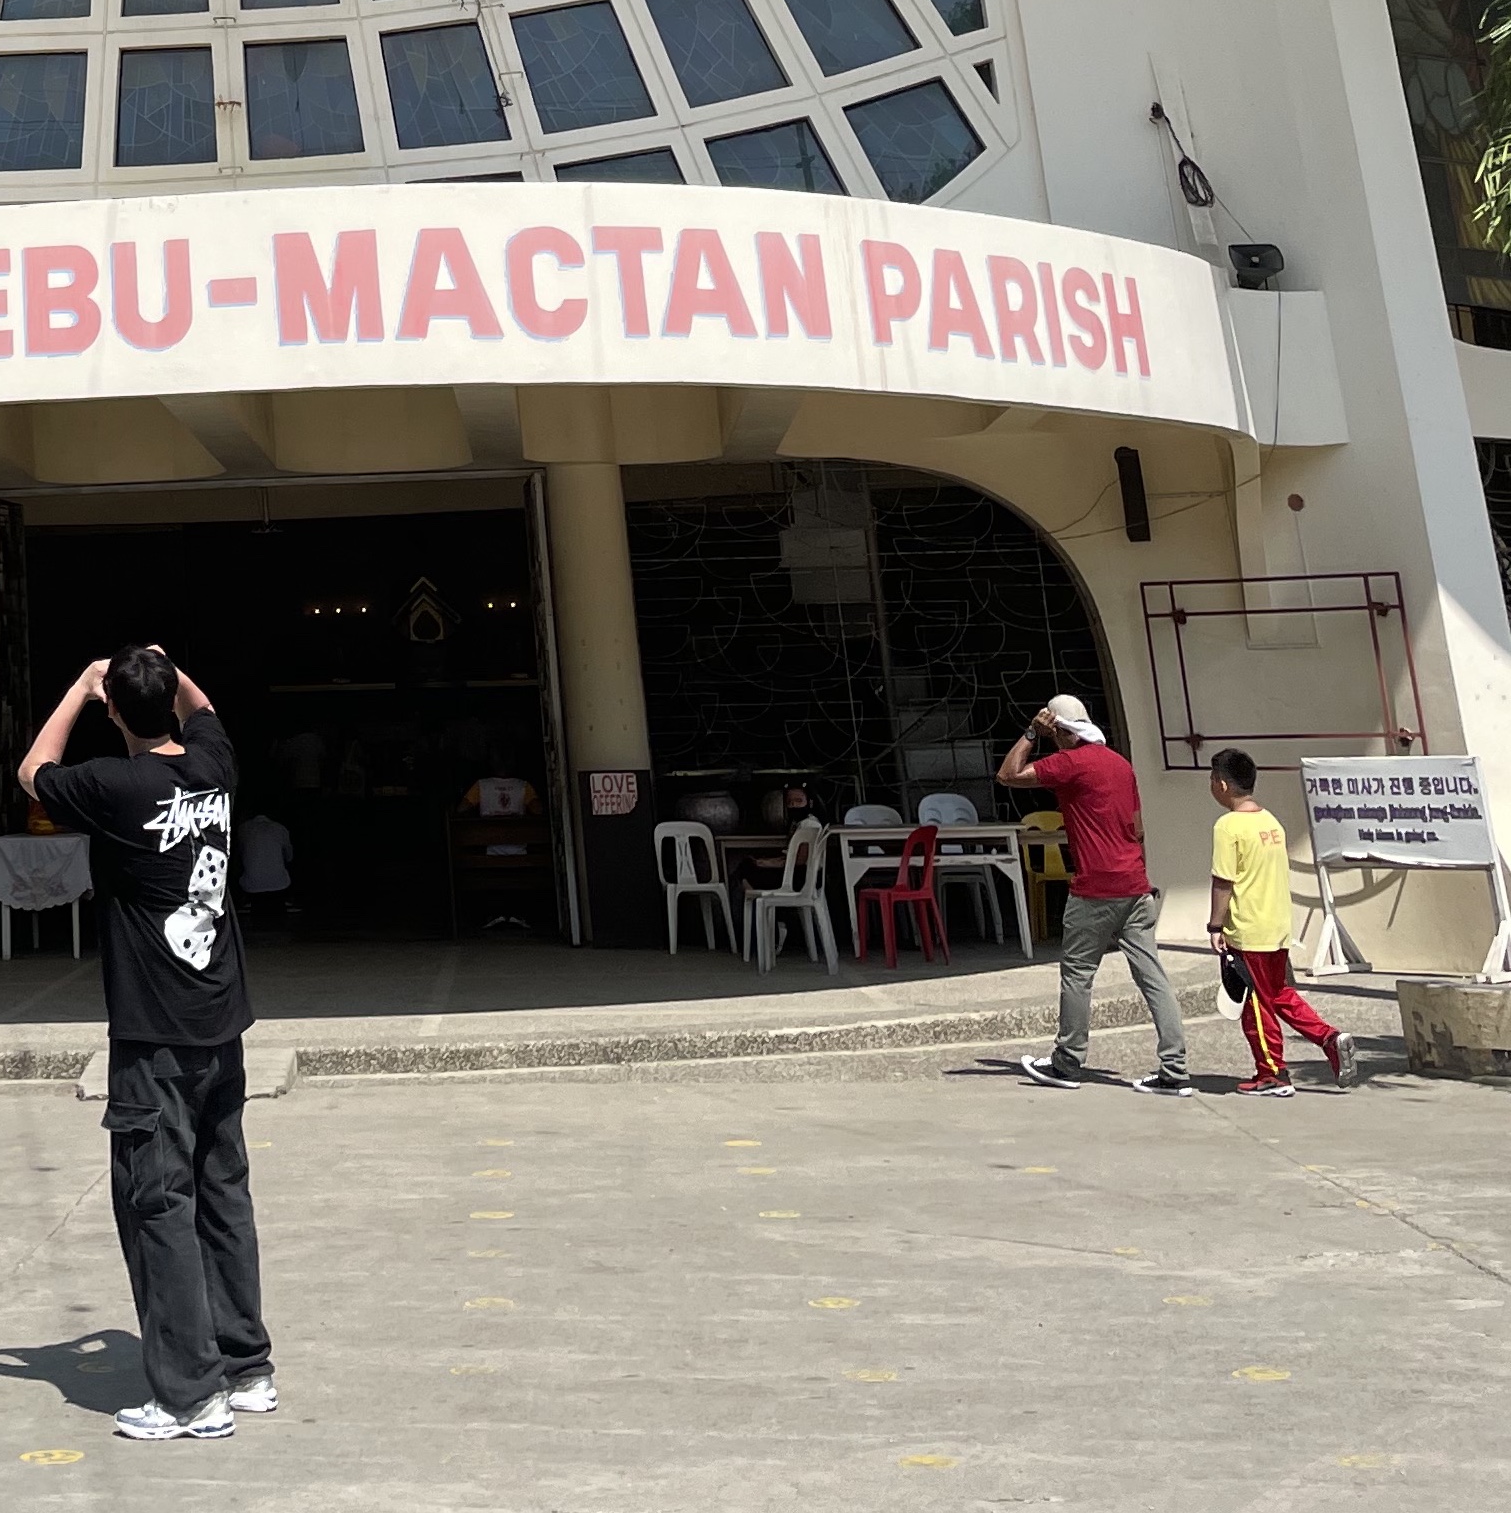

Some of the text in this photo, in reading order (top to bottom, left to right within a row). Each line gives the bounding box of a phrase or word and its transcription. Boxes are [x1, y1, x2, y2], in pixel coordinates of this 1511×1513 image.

[859, 238, 1152, 381] PARISH
[591, 774, 635, 793] LOVE
[1347, 777, 1385, 796] 미사가
